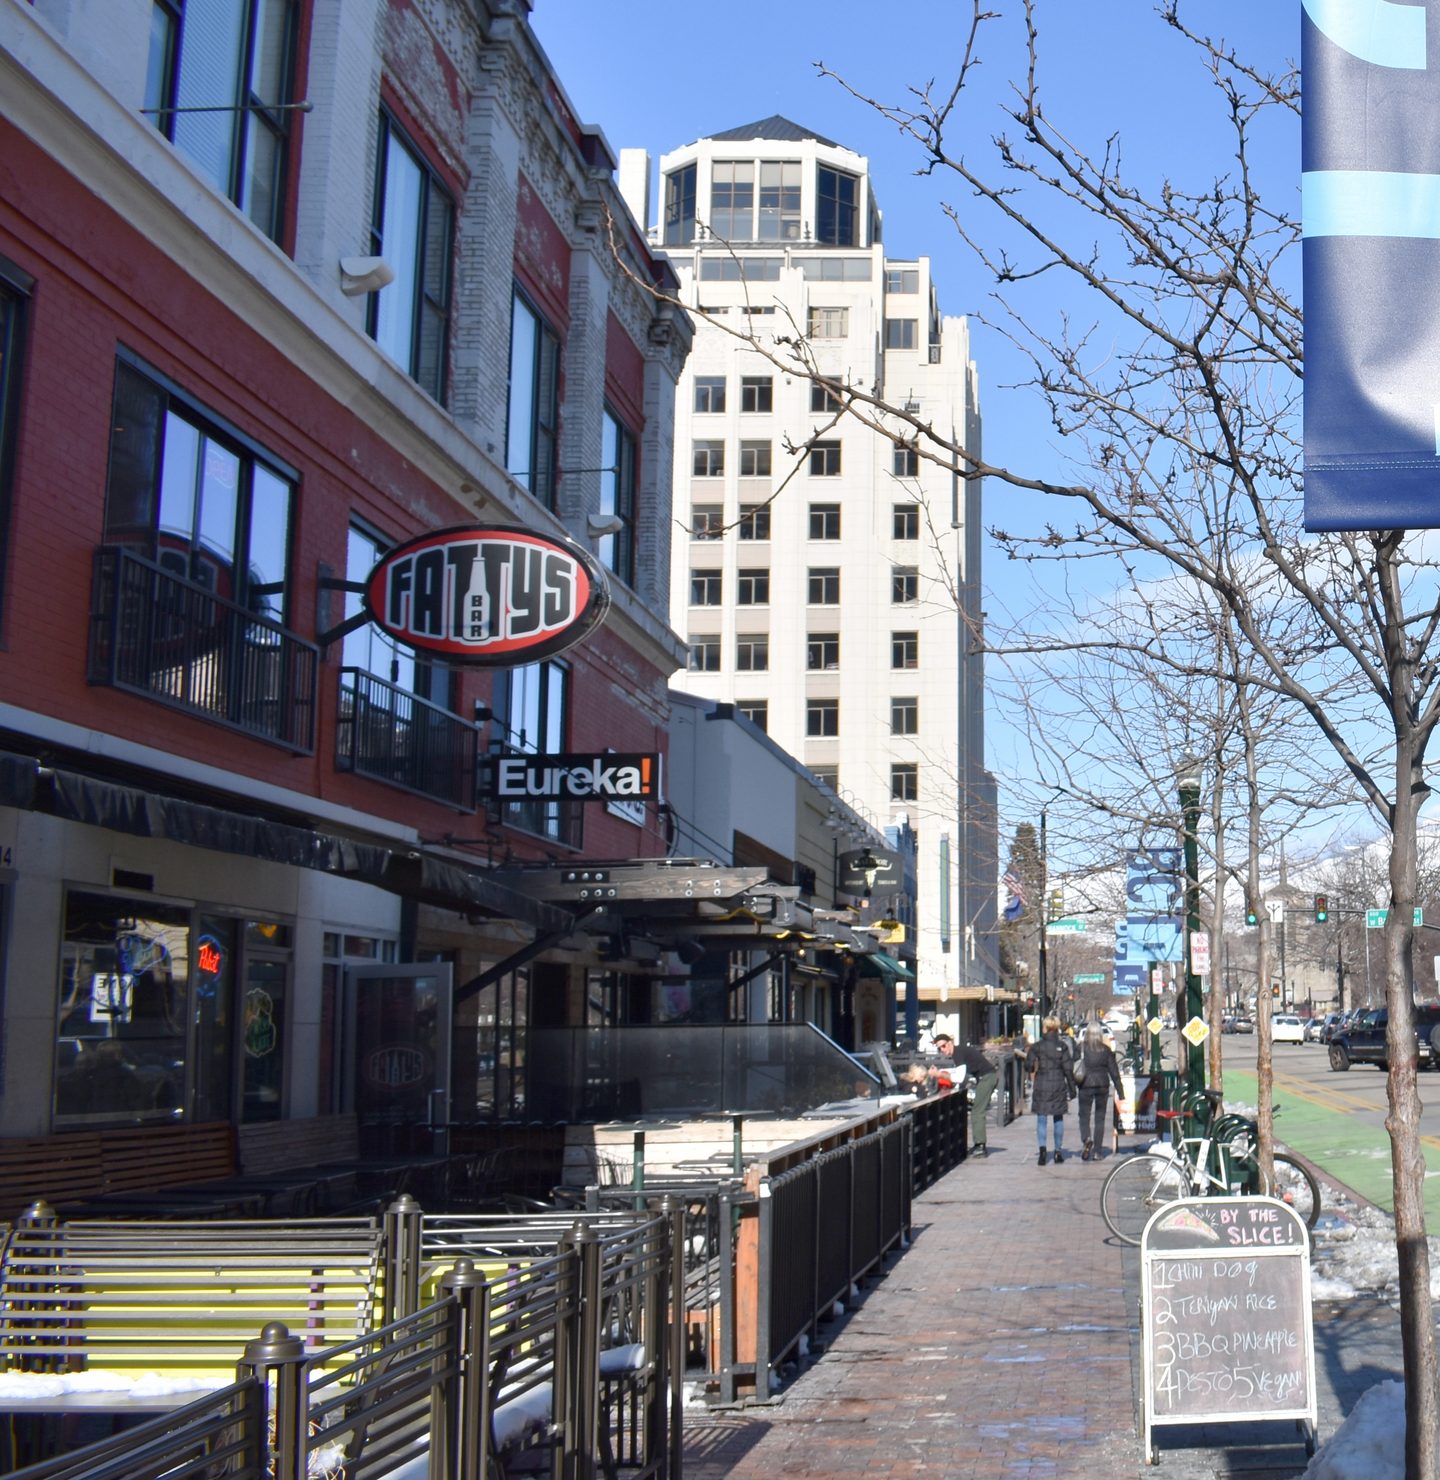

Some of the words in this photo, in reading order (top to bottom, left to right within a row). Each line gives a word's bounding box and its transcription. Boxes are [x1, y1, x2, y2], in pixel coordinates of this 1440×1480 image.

[390, 543, 572, 638] FATTYS
[471, 595, 482, 637] BAR
[498, 758, 651, 796] Eureka!
[1220, 1208, 1239, 1224] BY
[1249, 1208, 1279, 1223] THE
[1227, 1223, 1294, 1245] SLICE!
[1155, 1296, 1178, 1324] 2
[1154, 1331, 1176, 1367] 3
[1176, 1332, 1231, 1360] BBQ
[1156, 1365, 1178, 1406] 4
[1233, 1366, 1254, 1398] 5
